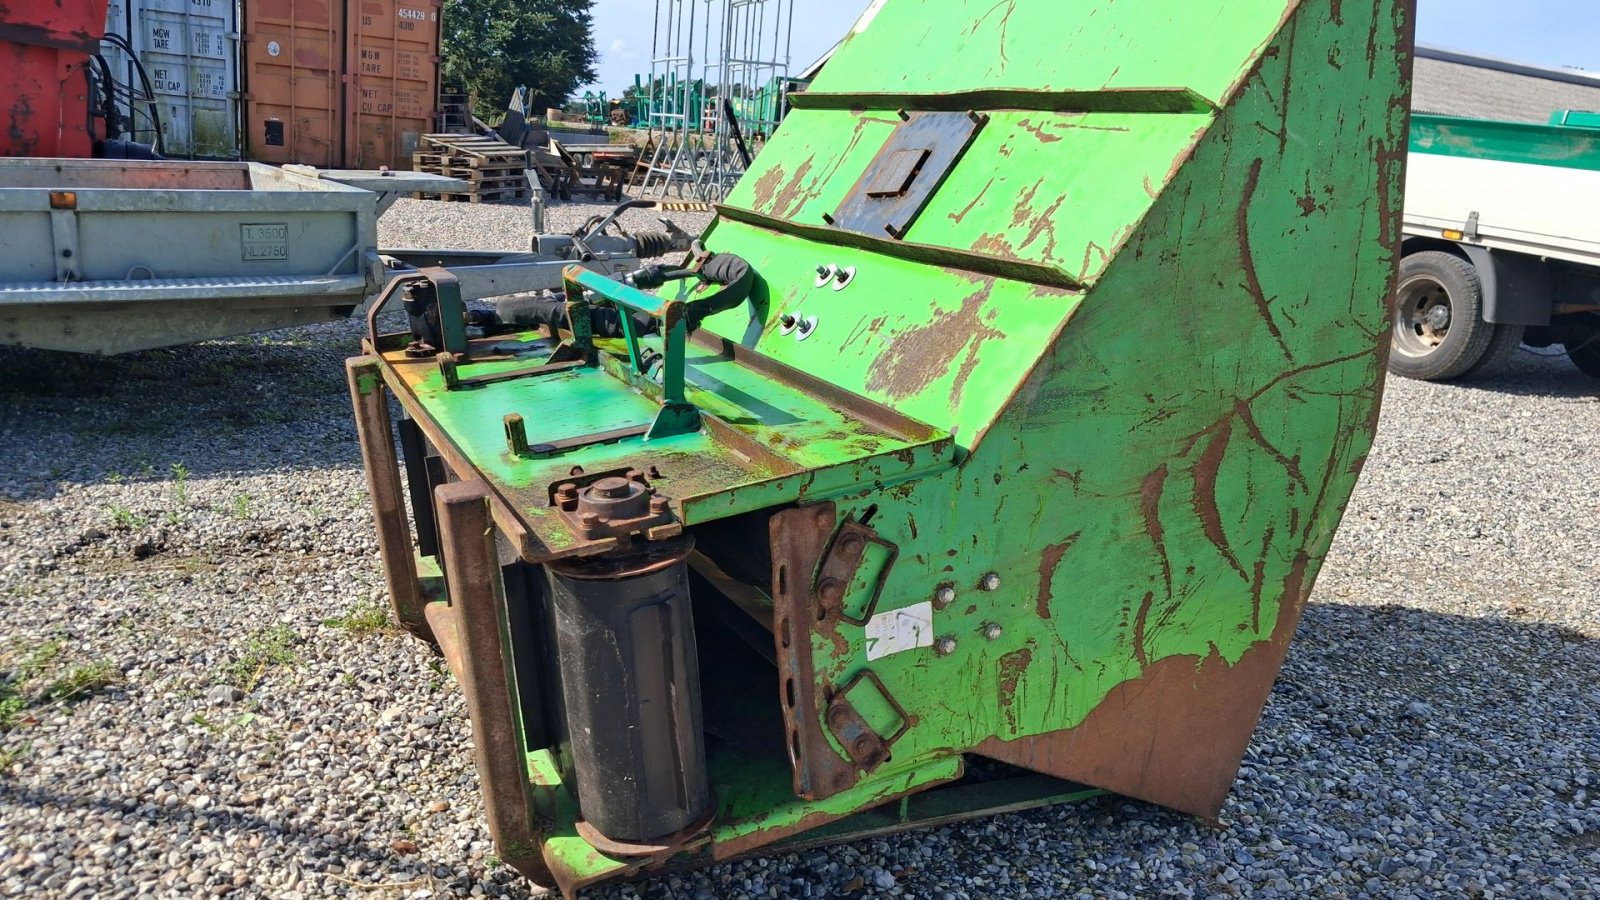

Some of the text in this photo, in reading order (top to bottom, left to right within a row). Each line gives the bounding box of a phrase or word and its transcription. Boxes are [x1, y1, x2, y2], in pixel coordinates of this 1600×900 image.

[398, 8, 436, 22] 454429 0
[362, 16, 372, 26] US
[398, 21, 415, 31] 4310
[152, 28, 170, 39] MGW
[153, 39, 169, 50] TARE
[361, 63, 381, 73] TARE
[154, 69, 167, 80] NET
[154, 80, 180, 91] CU CAP
[362, 89, 378, 99] NET
[362, 102, 372, 112] CU
[378, 103, 393, 113] CAP
[258, 228, 285, 239] 3500
